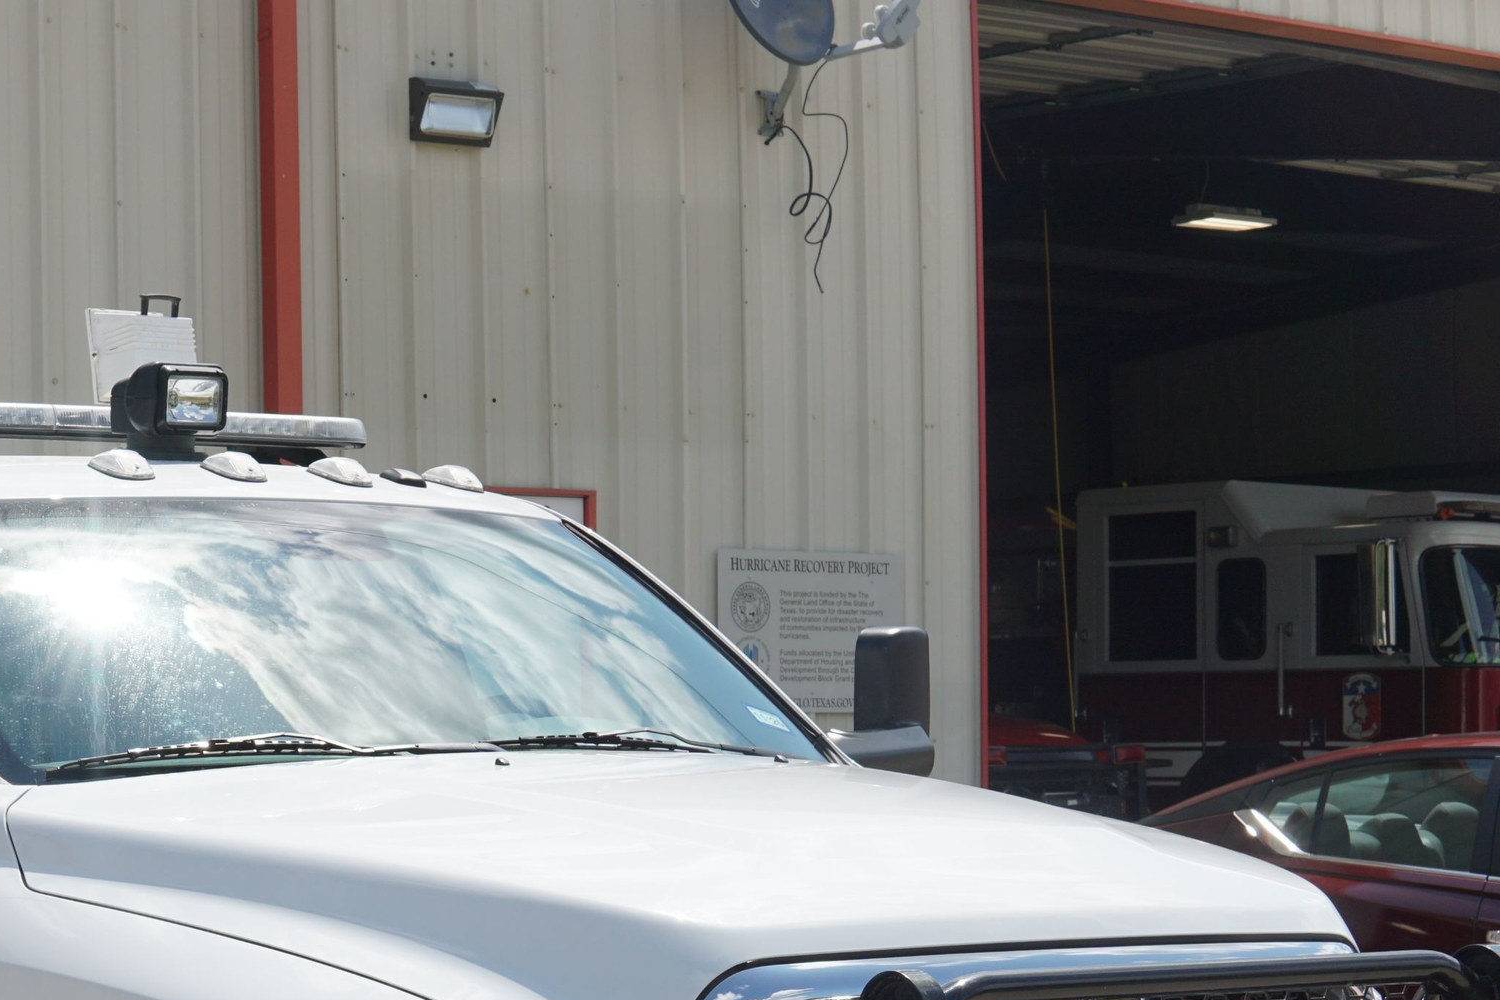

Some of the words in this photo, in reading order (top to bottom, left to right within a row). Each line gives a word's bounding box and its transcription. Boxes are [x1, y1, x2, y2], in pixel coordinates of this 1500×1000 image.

[730, 557, 791, 573] HURRICANE
[794, 559, 845, 574] RECOVERY
[848, 560, 890, 576] PROJECT
[793, 591, 812, 599] project
[840, 592, 847, 600] by
[779, 598, 802, 606] General
[806, 608, 827, 616] provide
[825, 650, 832, 658] by
[780, 658, 812, 666] Department
[780, 666, 816, 674] Development
[780, 674, 816, 683] Development
